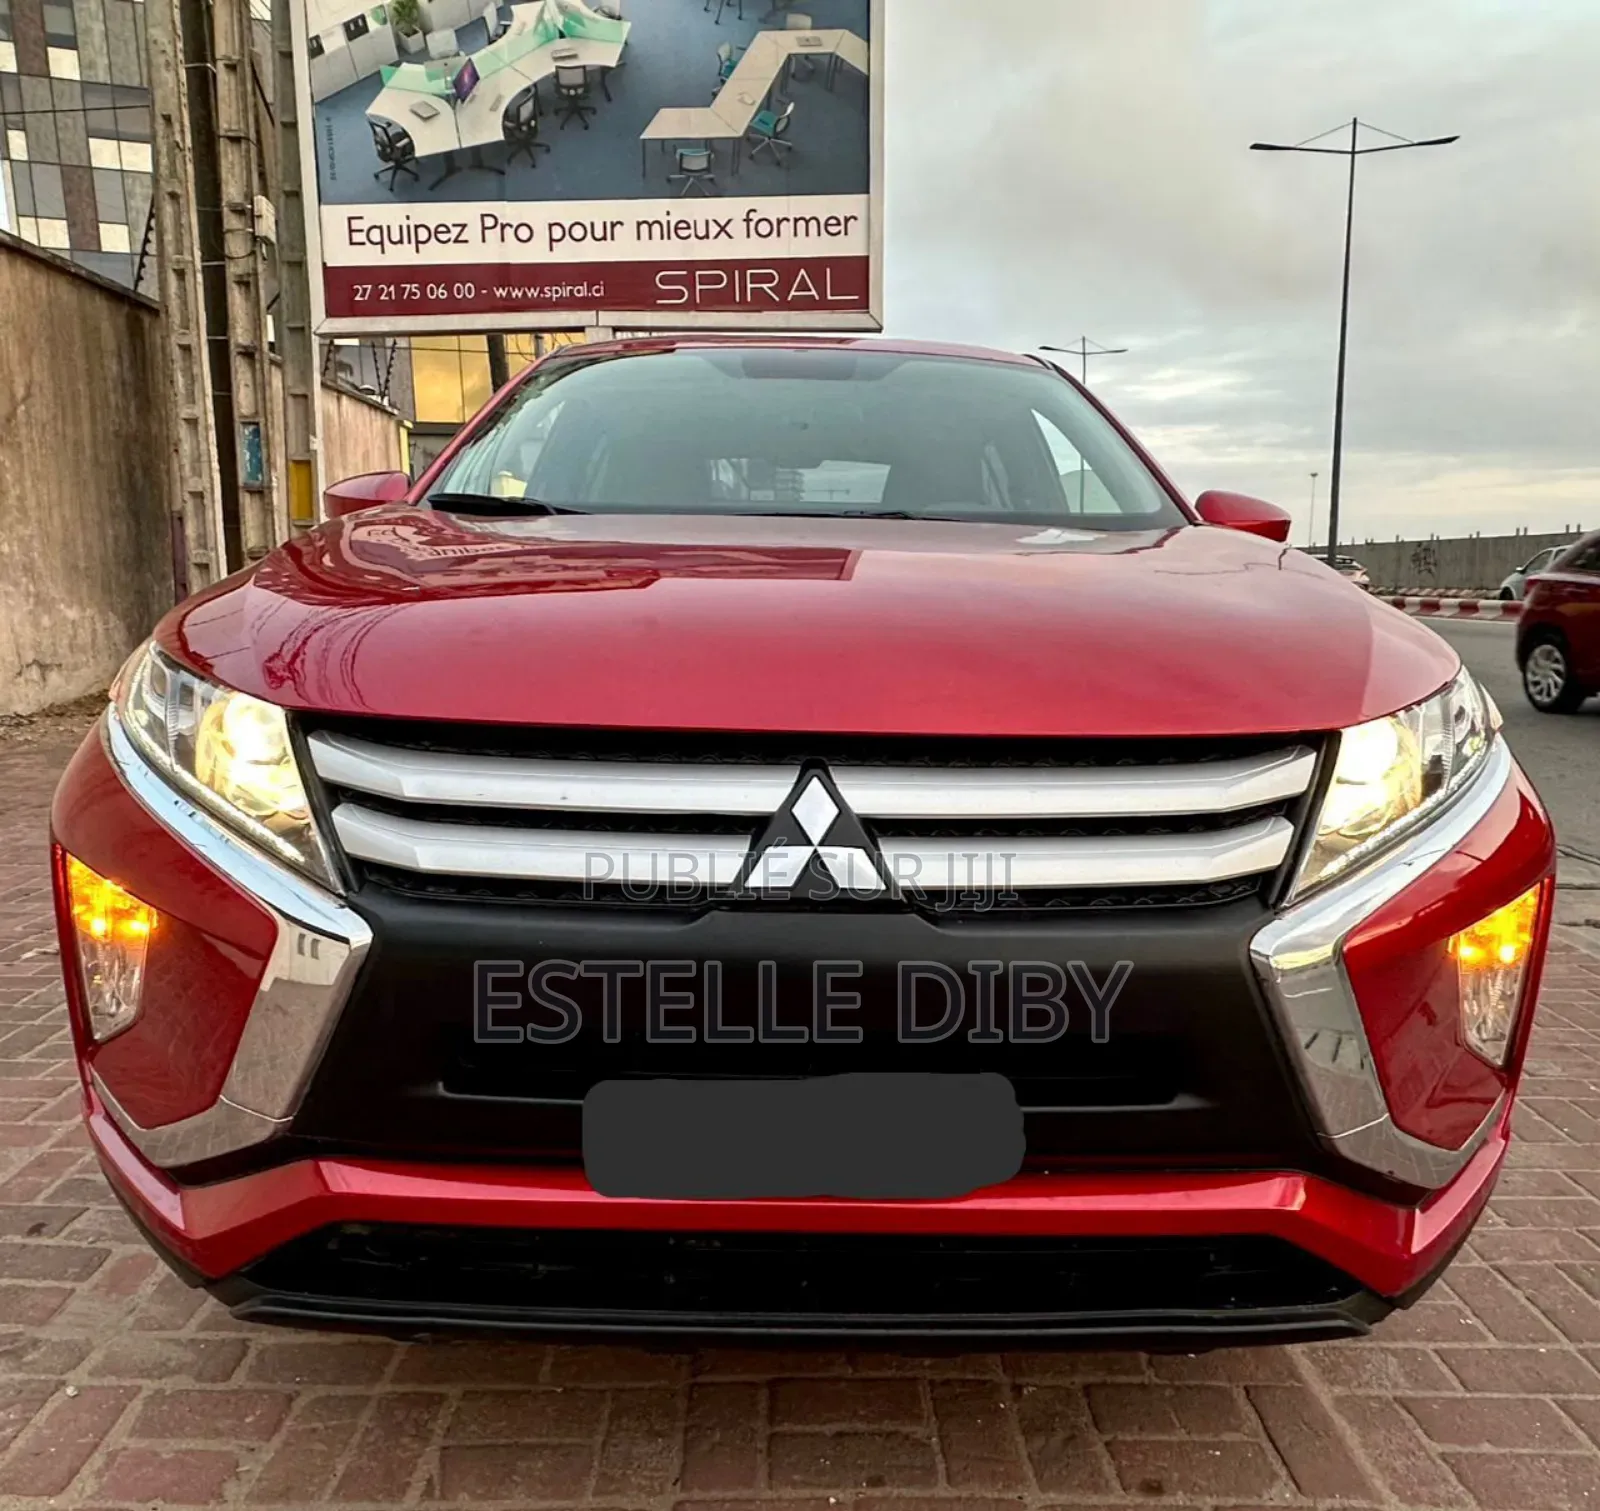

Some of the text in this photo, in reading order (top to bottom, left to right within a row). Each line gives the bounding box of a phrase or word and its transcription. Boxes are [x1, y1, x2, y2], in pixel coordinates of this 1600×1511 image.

[347, 208, 858, 254] Equipez Pro pour mieux former
[353, 285, 372, 301] 27
[379, 285, 396, 300] 21
[401, 284, 421, 299] 75
[427, 283, 448, 299] 06
[453, 283, 475, 298] 00
[493, 281, 605, 301] www.spiral.ci
[655, 267, 859, 304] SPIRAL
